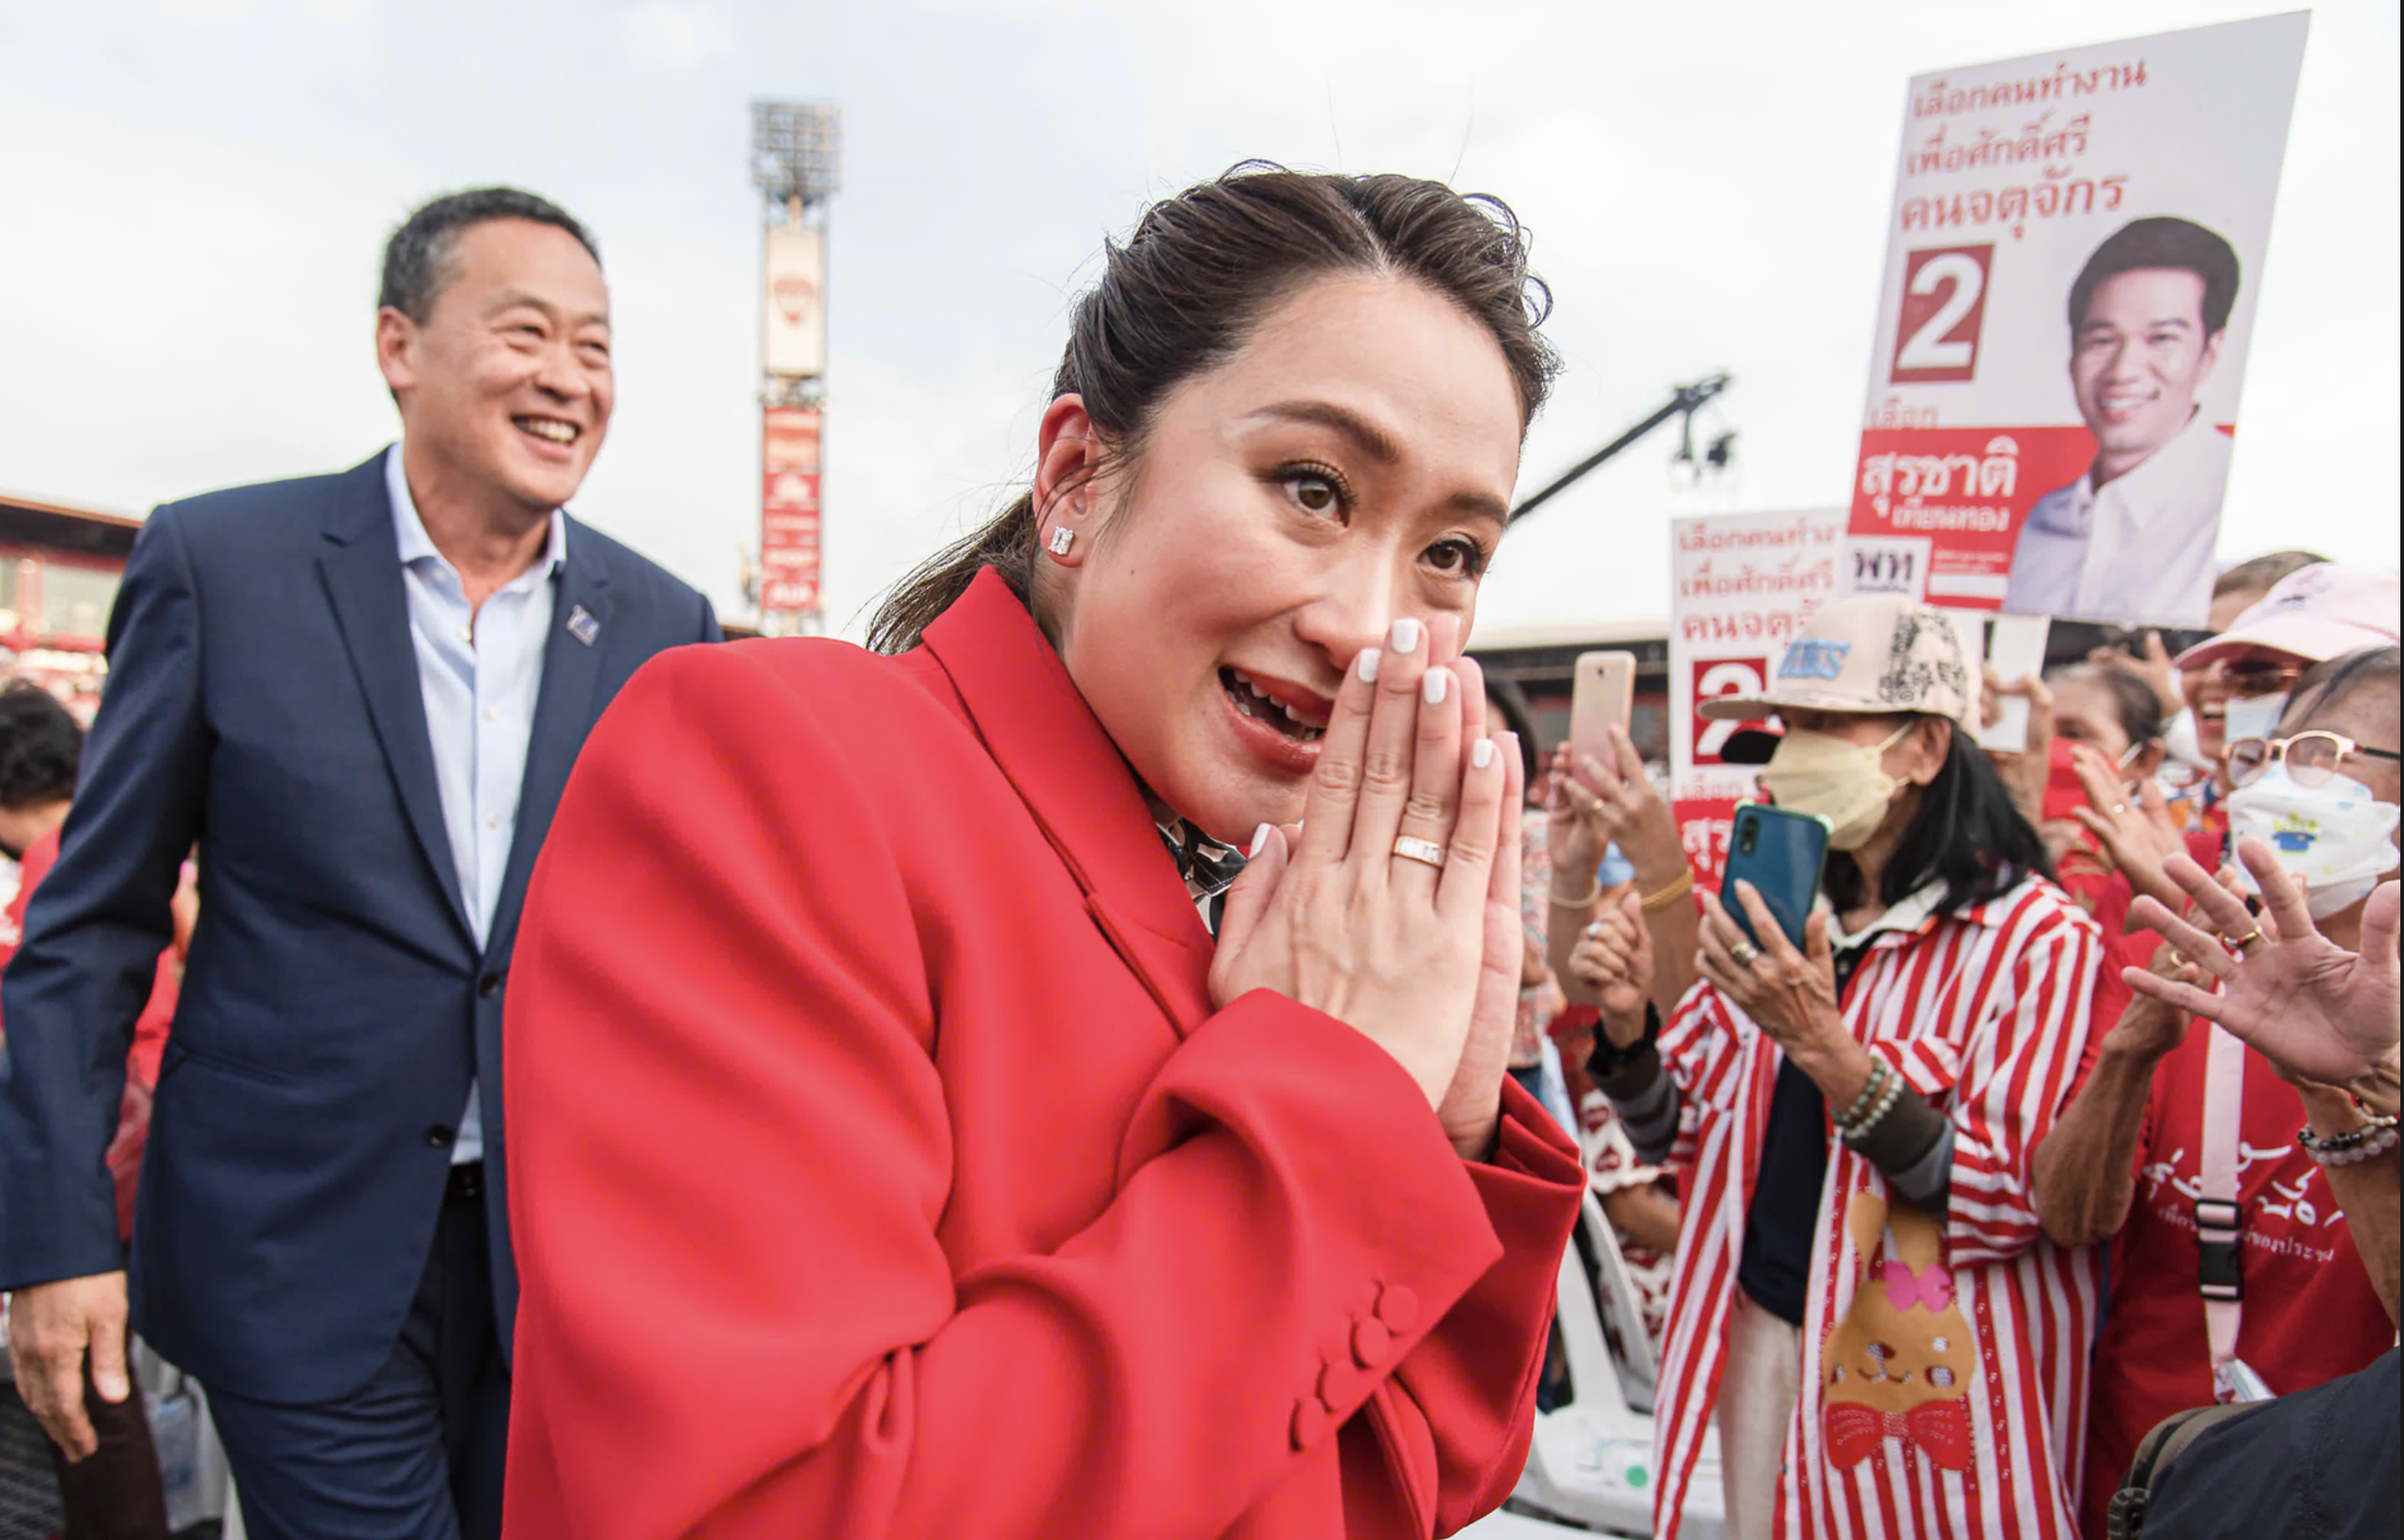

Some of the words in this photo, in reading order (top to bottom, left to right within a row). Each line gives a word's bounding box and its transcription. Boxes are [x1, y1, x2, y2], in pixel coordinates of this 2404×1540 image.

[1912, 57, 2148, 119] เลือกคนทำงาน
[1905, 108, 2092, 177] เพื่อศักดิ์ศรี
[1900, 166, 2129, 239] คนจตุจักร
[1896, 252, 1984, 370] 2
[1861, 435, 2019, 517] สุรชาติ
[1679, 517, 1837, 552] เลือกคนทำง
[1891, 496, 2011, 532] เทียนทอง
